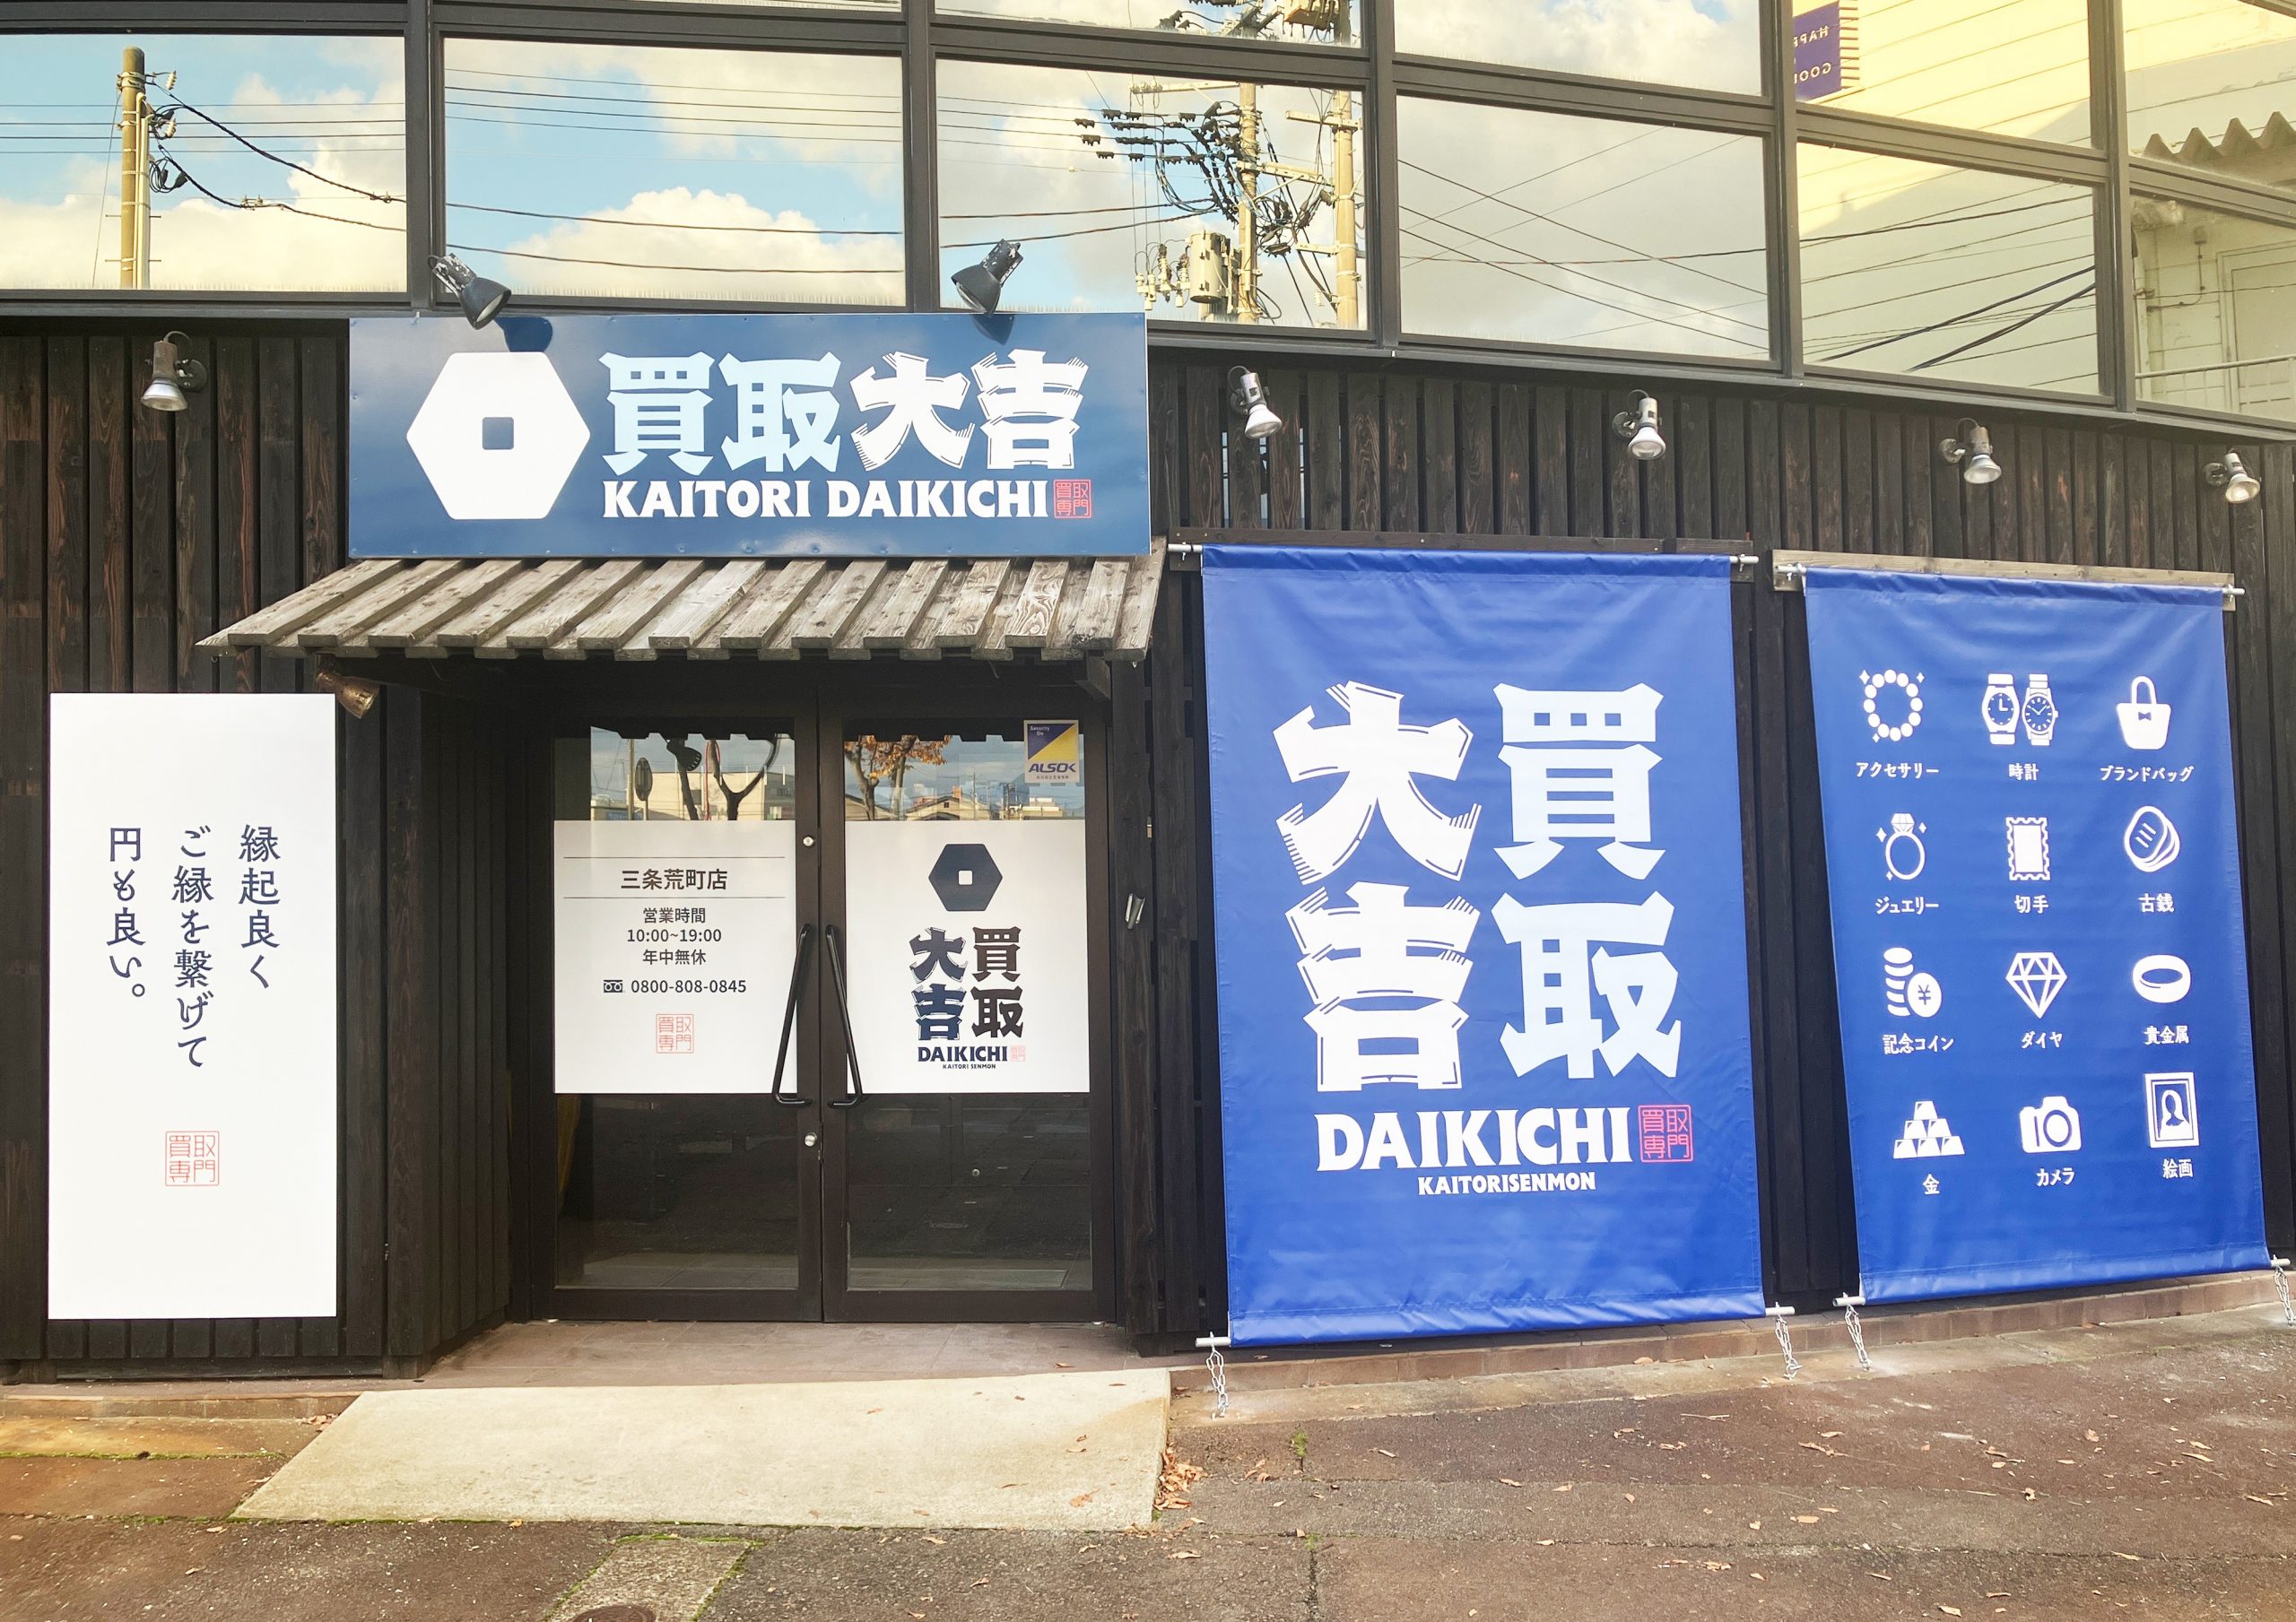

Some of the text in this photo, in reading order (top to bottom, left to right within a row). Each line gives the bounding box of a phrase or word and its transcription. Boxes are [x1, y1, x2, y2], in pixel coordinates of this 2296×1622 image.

[598, 349, 1089, 476] 買取大吉
[603, 480, 1048, 518] KAITORI DAIKICHI
[1029, 763, 1076, 773] ALSOK
[1856, 760, 1940, 780] アクセサリー
[2007, 762, 2040, 782] 時計
[2099, 764, 2196, 784] ブランドバッグ
[621, 868, 728, 890] 三条荒町店
[106, 827, 146, 999] 円も良い。
[238, 824, 281, 989] 縁起良く
[1874, 896, 1940, 915] ジュエリー
[2013, 894, 2049, 914] 切手
[2137, 892, 2176, 914] 古銭
[642, 906, 706, 924] 営業時間
[171, 824, 214, 1068] ご縁を繋げて
[642, 949, 707, 966] 年中無休
[631, 979, 747, 993] 0800-808-0845
[1882, 1032, 1955, 1055] 記念コイン
[2020, 1028, 2064, 1050] ダイヤ
[2143, 1024, 2190, 1046] 貴金属
[918, 1045, 1008, 1062] DAIKICHI
[1314, 1106, 1633, 1172] DAIKICHI
[2035, 1167, 2076, 1187] カメラ
[2162, 1158, 2194, 1179] 絵画
[1922, 1173, 1941, 1196] 金
